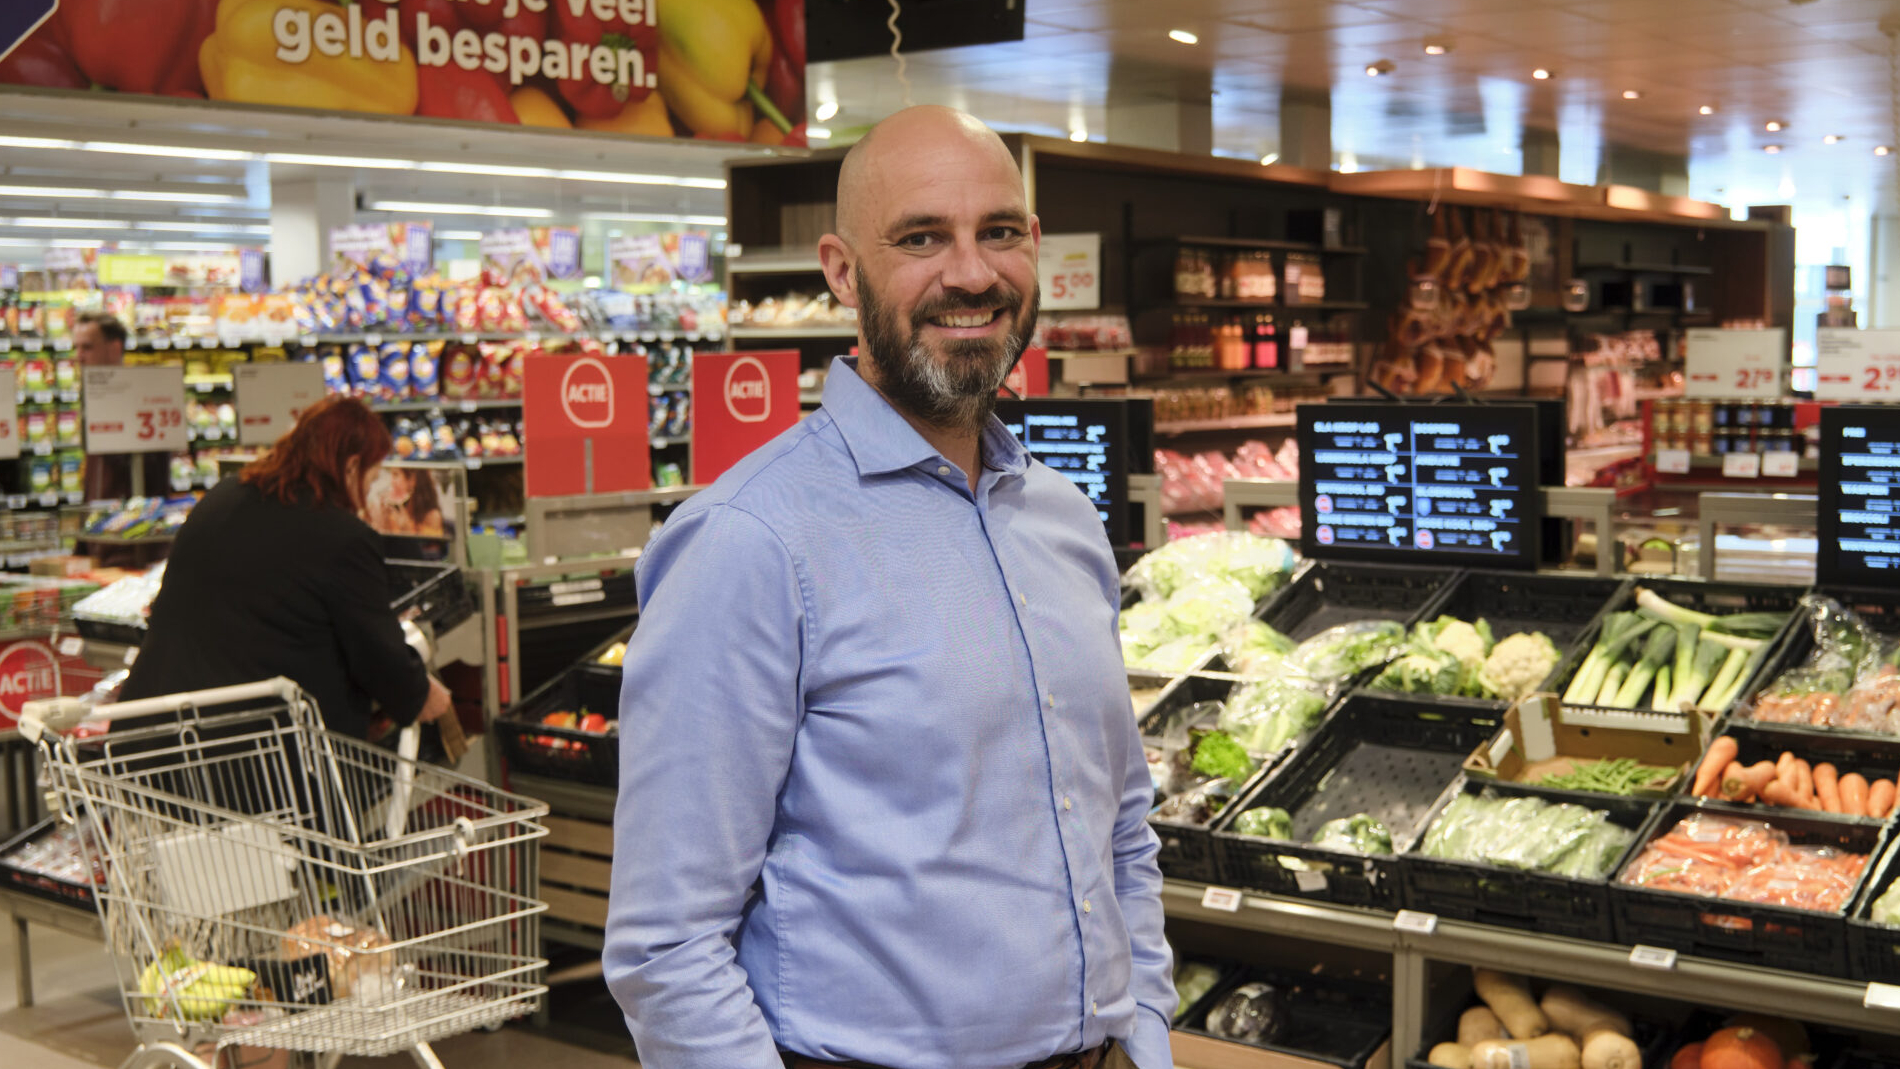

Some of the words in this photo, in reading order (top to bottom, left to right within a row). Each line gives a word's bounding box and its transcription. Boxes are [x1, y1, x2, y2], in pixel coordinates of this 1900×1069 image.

[272, 4, 400, 63] geld
[416, 12, 657, 88] besparen.
[731, 381, 764, 399] ACTIE
[1862, 365, 1900, 391] 2.9
[568, 384, 608, 403] ACTIE
[0, 669, 53, 695] ACTIE
